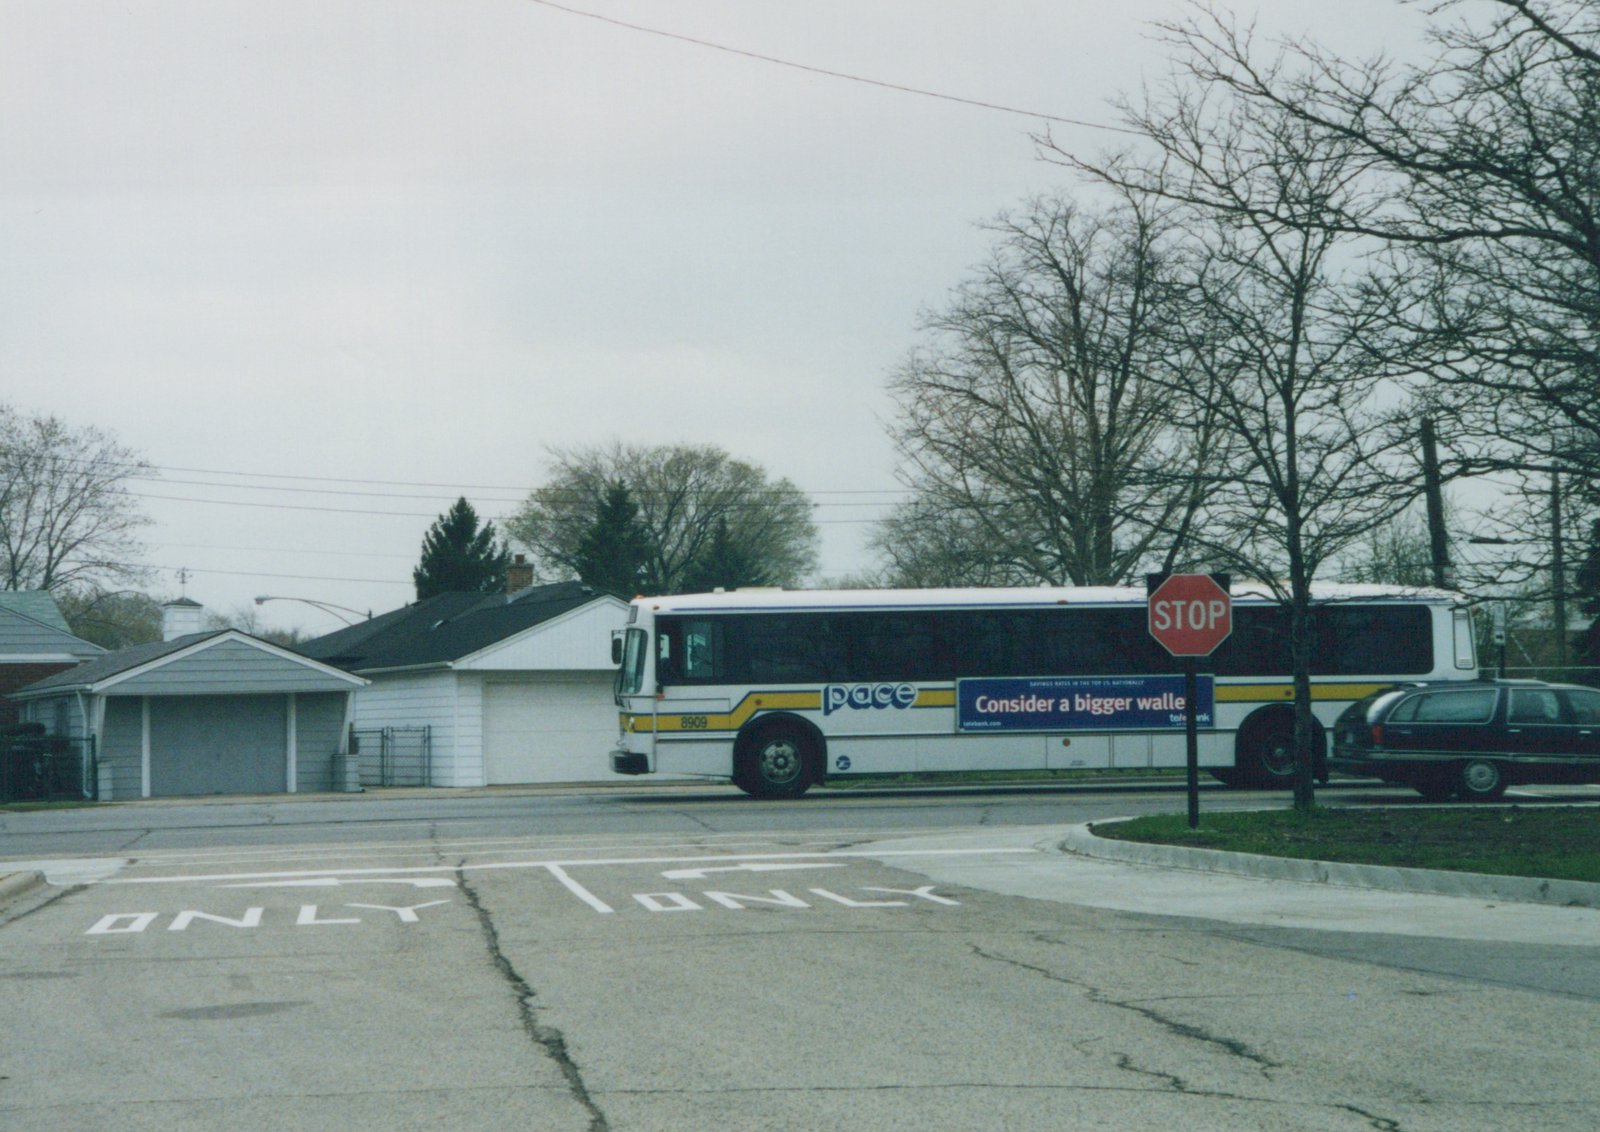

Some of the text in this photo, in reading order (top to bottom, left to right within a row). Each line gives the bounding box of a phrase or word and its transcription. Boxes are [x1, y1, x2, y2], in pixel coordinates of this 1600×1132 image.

[1154, 600, 1226, 630] STOP
[823, 684, 917, 716] pace
[975, 692, 1192, 715] Consider a bigger walle
[681, 716, 708, 729] 8909
[632, 886, 962, 912] ONLY
[85, 900, 453, 934] ONLY
